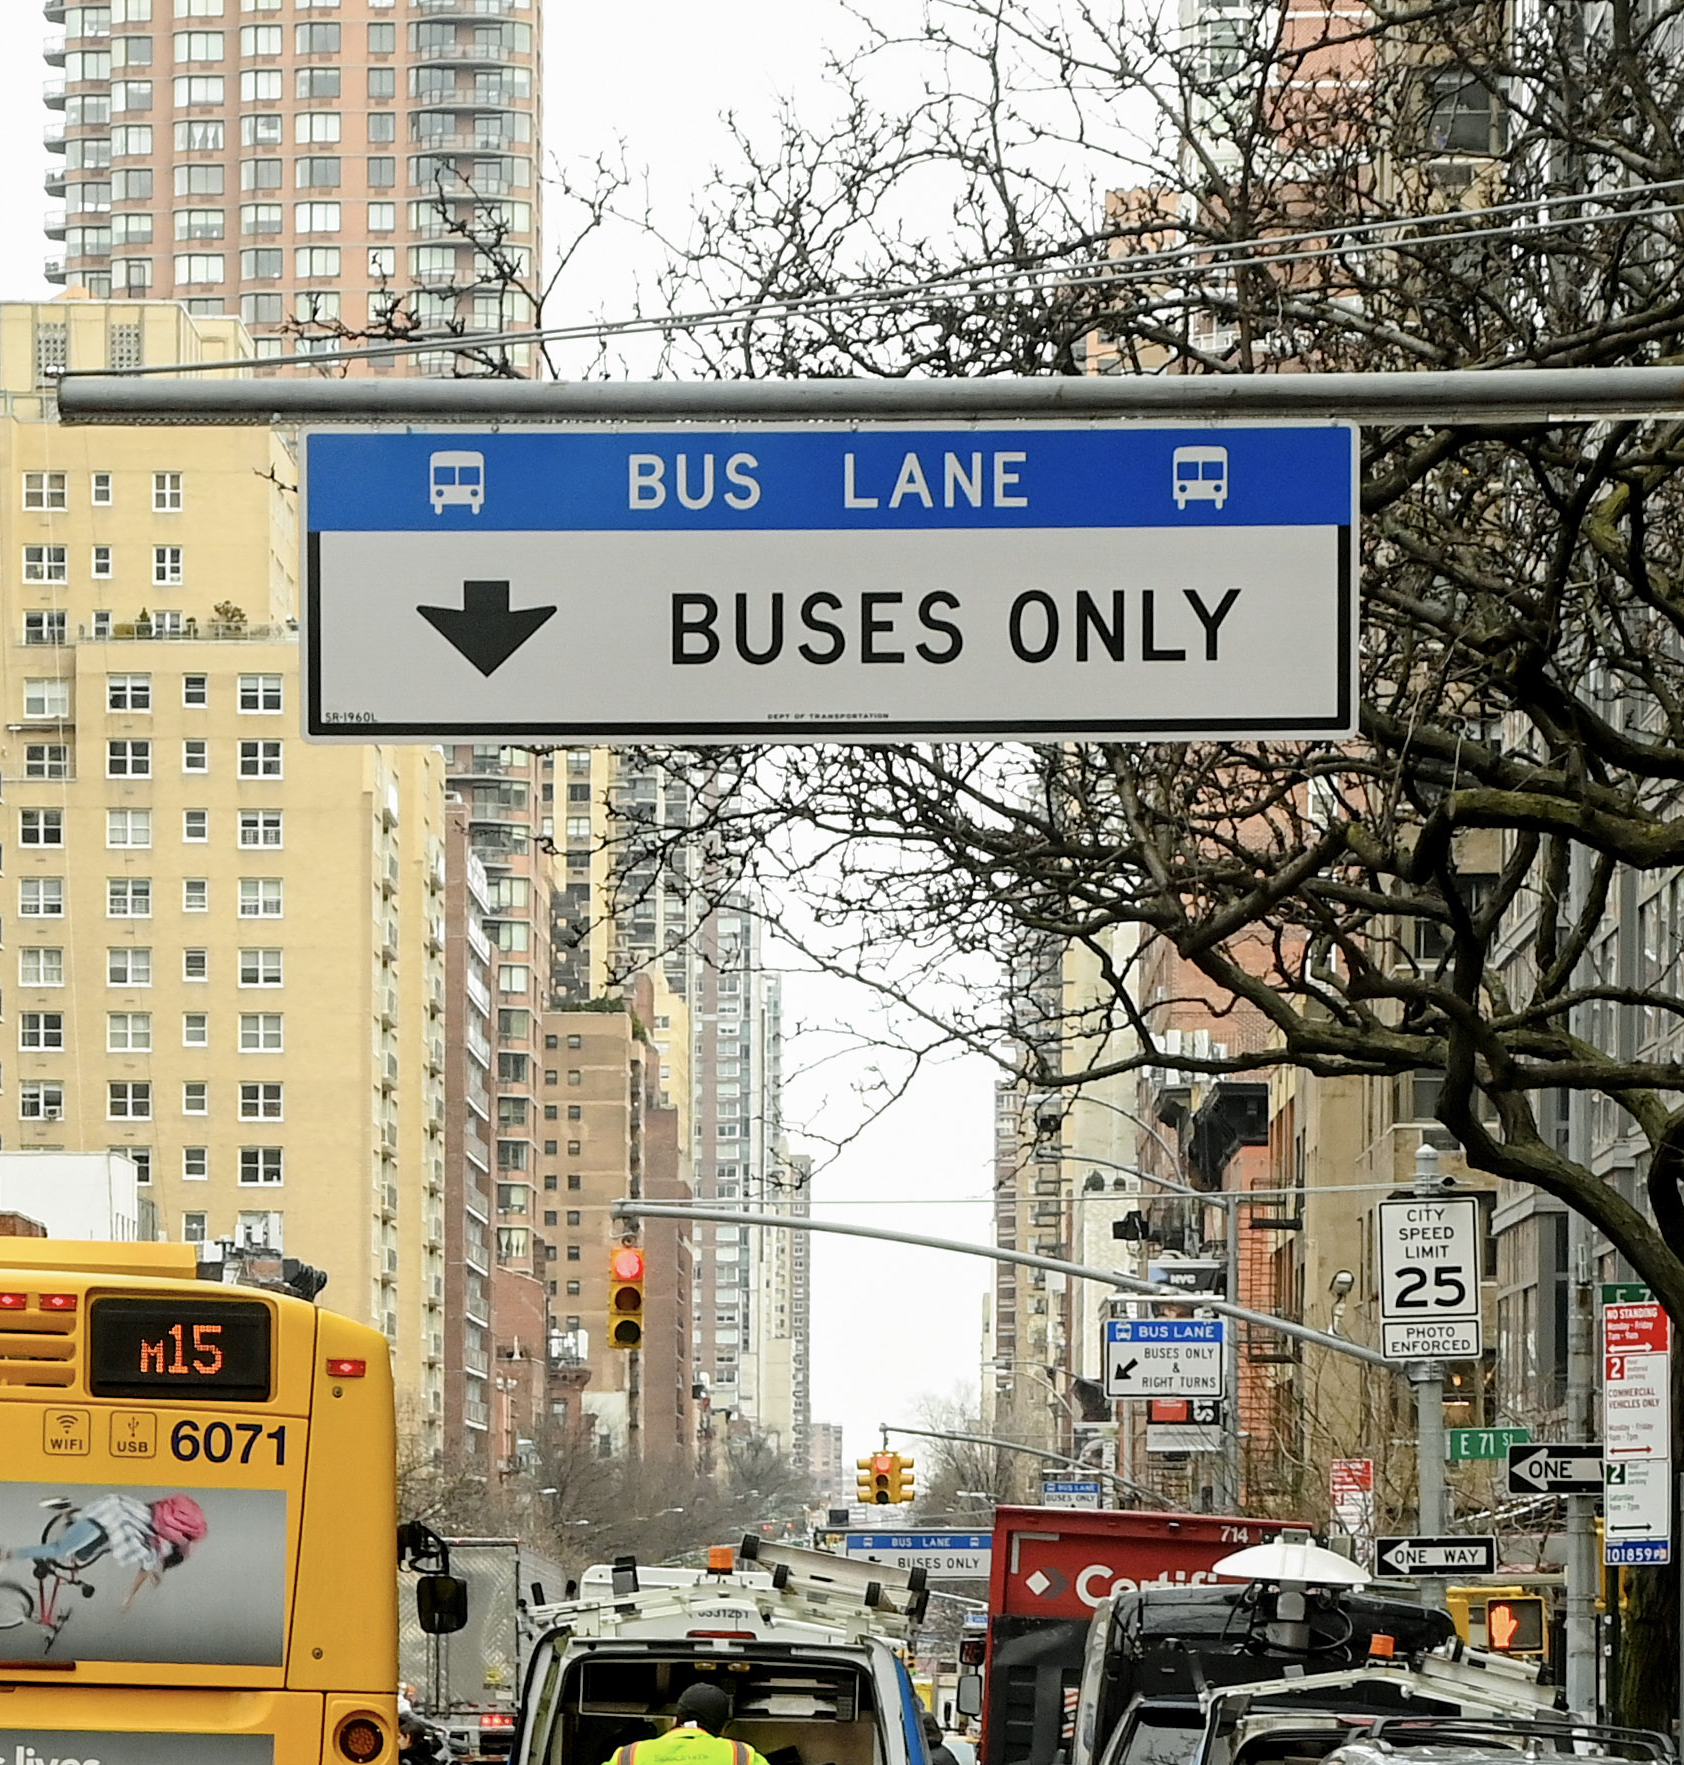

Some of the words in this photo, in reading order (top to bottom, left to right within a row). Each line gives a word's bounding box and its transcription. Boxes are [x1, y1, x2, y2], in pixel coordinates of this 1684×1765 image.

[628, 453, 761, 511] BUS
[843, 451, 1029, 510] LANE
[671, 590, 964, 666] BUSES
[1009, 588, 1241, 664] ONLY
[809, 712, 889, 720] TRANSPORTATION
[1407, 1208, 1445, 1222] CITY
[1398, 1227, 1454, 1241] SPEED
[1405, 1245, 1449, 1259] LIMIT
[1170, 1274, 1197, 1285] NYC
[1395, 1266, 1466, 1308] 25
[1607, 1309, 1618, 1320] NO
[1619, 1307, 1658, 1320] STANDING
[1138, 1326, 1168, 1338] BUS
[1174, 1326, 1215, 1338] LANE
[1406, 1326, 1455, 1339] PHOTO
[1391, 1339, 1471, 1353] ENFORCED
[1144, 1348, 1179, 1360] BUSES
[1185, 1348, 1215, 1360] ONLY
[1172, 1362, 1180, 1374] &
[1142, 1376, 1173, 1389] RIGHT
[1180, 1376, 1216, 1388] TURNS
[1608, 1388, 1656, 1398] COMMERCIAL
[1609, 1400, 1641, 1409] VEHICLES
[1642, 1399, 1660, 1408] ONLY
[50, 1438, 83, 1451] WIFI
[117, 1440, 148, 1453] USB
[171, 1420, 287, 1466] 6071
[1461, 1434, 1470, 1455] E
[1478, 1433, 1494, 1455] 71
[1528, 1460, 1573, 1479] ONE
[1220, 1526, 1249, 1543] 714
[892, 1537, 912, 1547] BUS
[922, 1537, 951, 1547] LANE
[1395, 1550, 1427, 1564] ONE
[1444, 1549, 1479, 1563] WAY
[1606, 1547, 1652, 1562] 101859
[947, 1557, 980, 1569] ONLY
